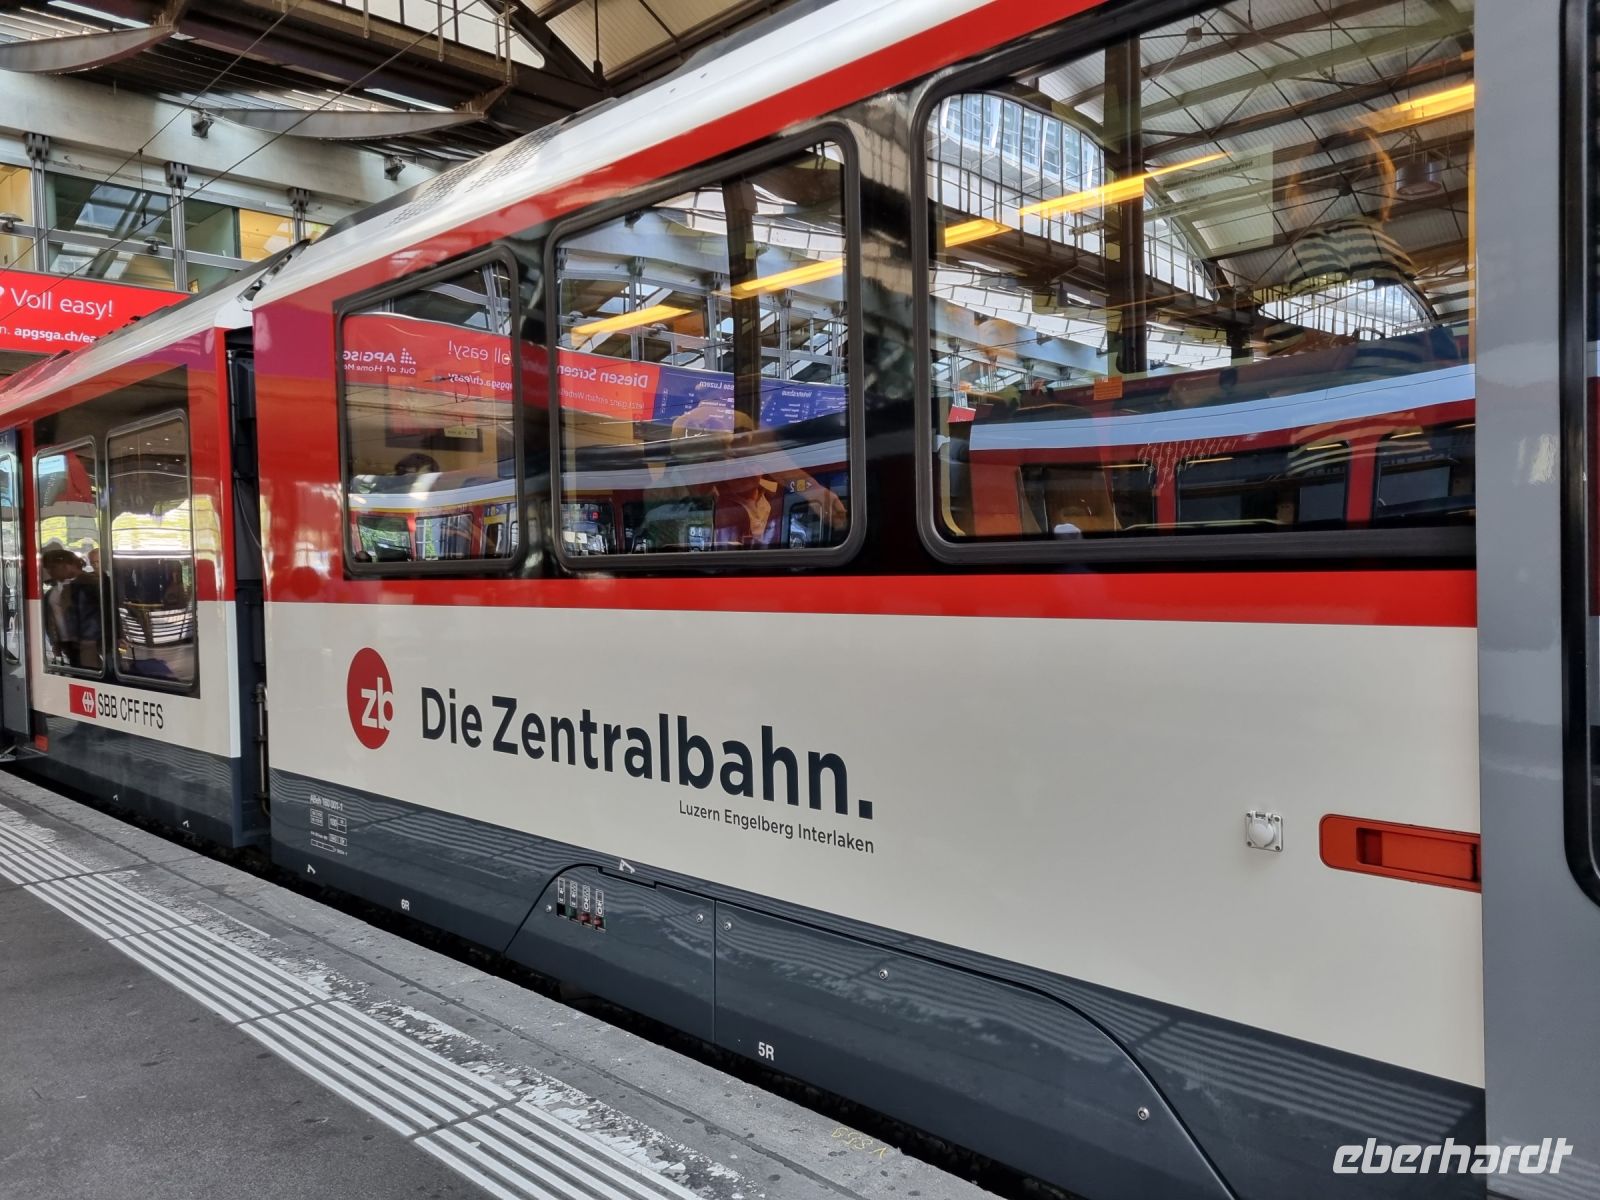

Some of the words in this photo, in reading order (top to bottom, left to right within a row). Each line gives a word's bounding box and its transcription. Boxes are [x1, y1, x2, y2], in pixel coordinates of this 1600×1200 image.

[11, 287, 52, 310] Voll
[60, 298, 113, 320] easy!
[97, 693, 118, 718] SBB
[120, 697, 140, 723] CFF
[142, 701, 164, 729] FFS
[361, 677, 394, 731] zb
[421, 686, 483, 748] Die
[492, 695, 873, 820] Zentralbahn.
[679, 799, 721, 822] Luzern
[724, 809, 794, 839] Engelberg
[798, 823, 874, 854] Interlaken
[758, 1041, 775, 1061] 5R
